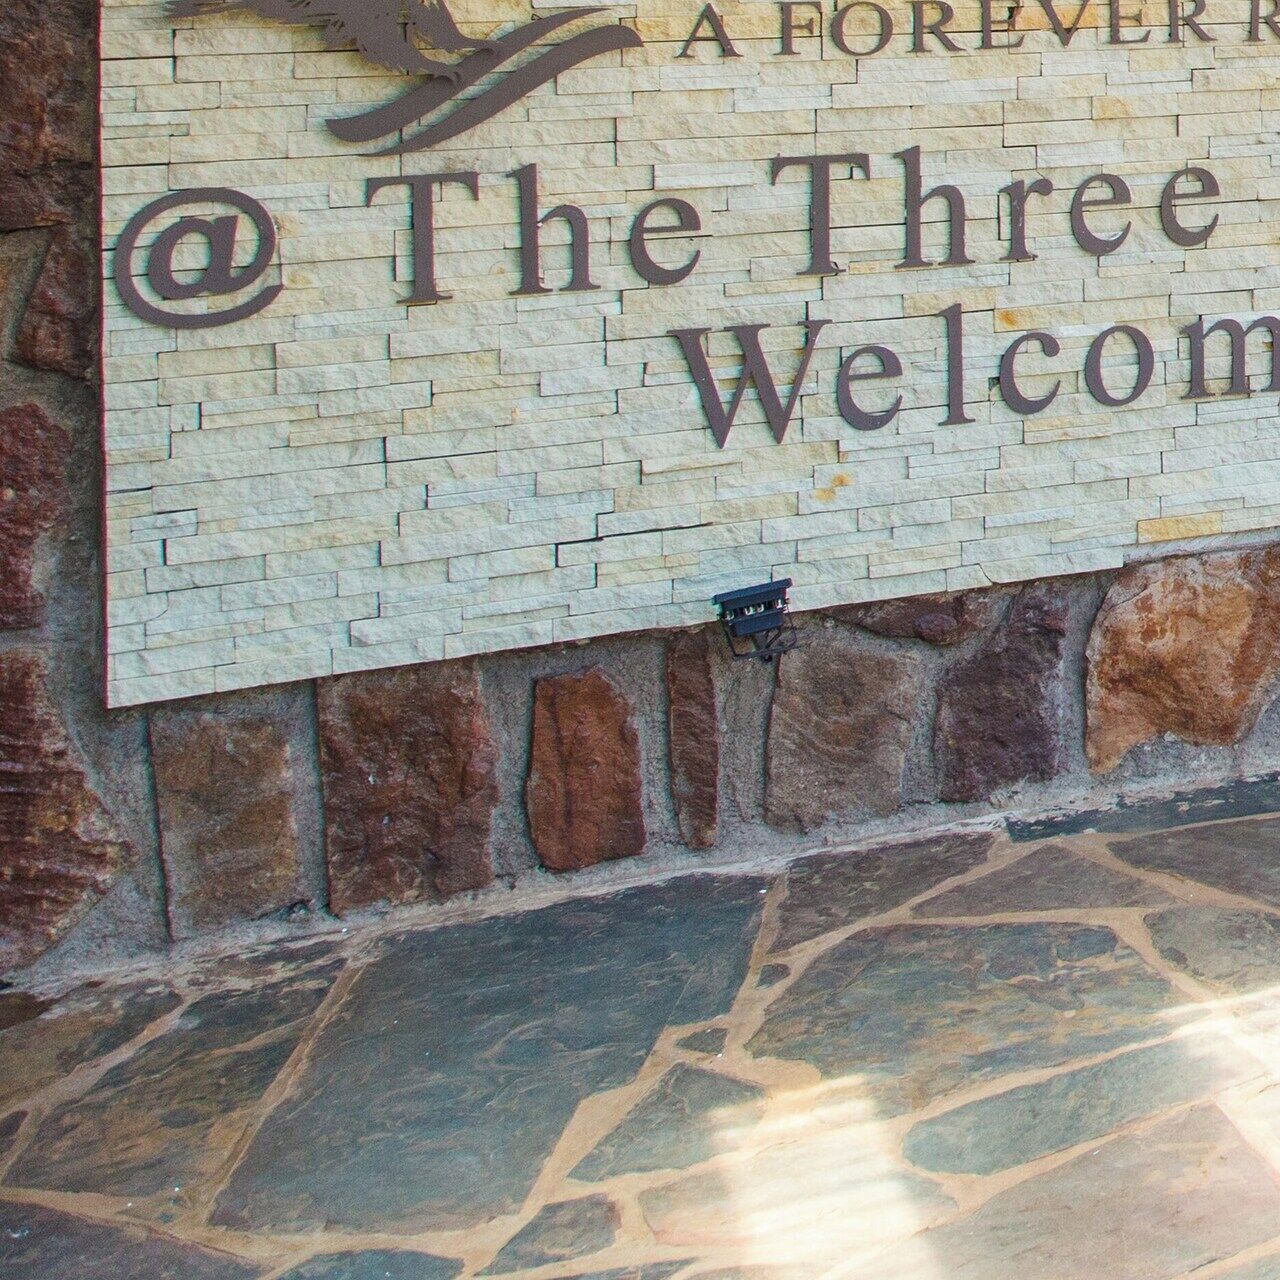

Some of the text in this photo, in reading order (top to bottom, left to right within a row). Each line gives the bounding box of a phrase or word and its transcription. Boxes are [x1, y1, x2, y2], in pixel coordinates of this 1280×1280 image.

[677, 1, 743, 58] A
[114, 186, 285, 329] @
[365, 161, 703, 304] The
[768, 145, 1220, 276] Three
